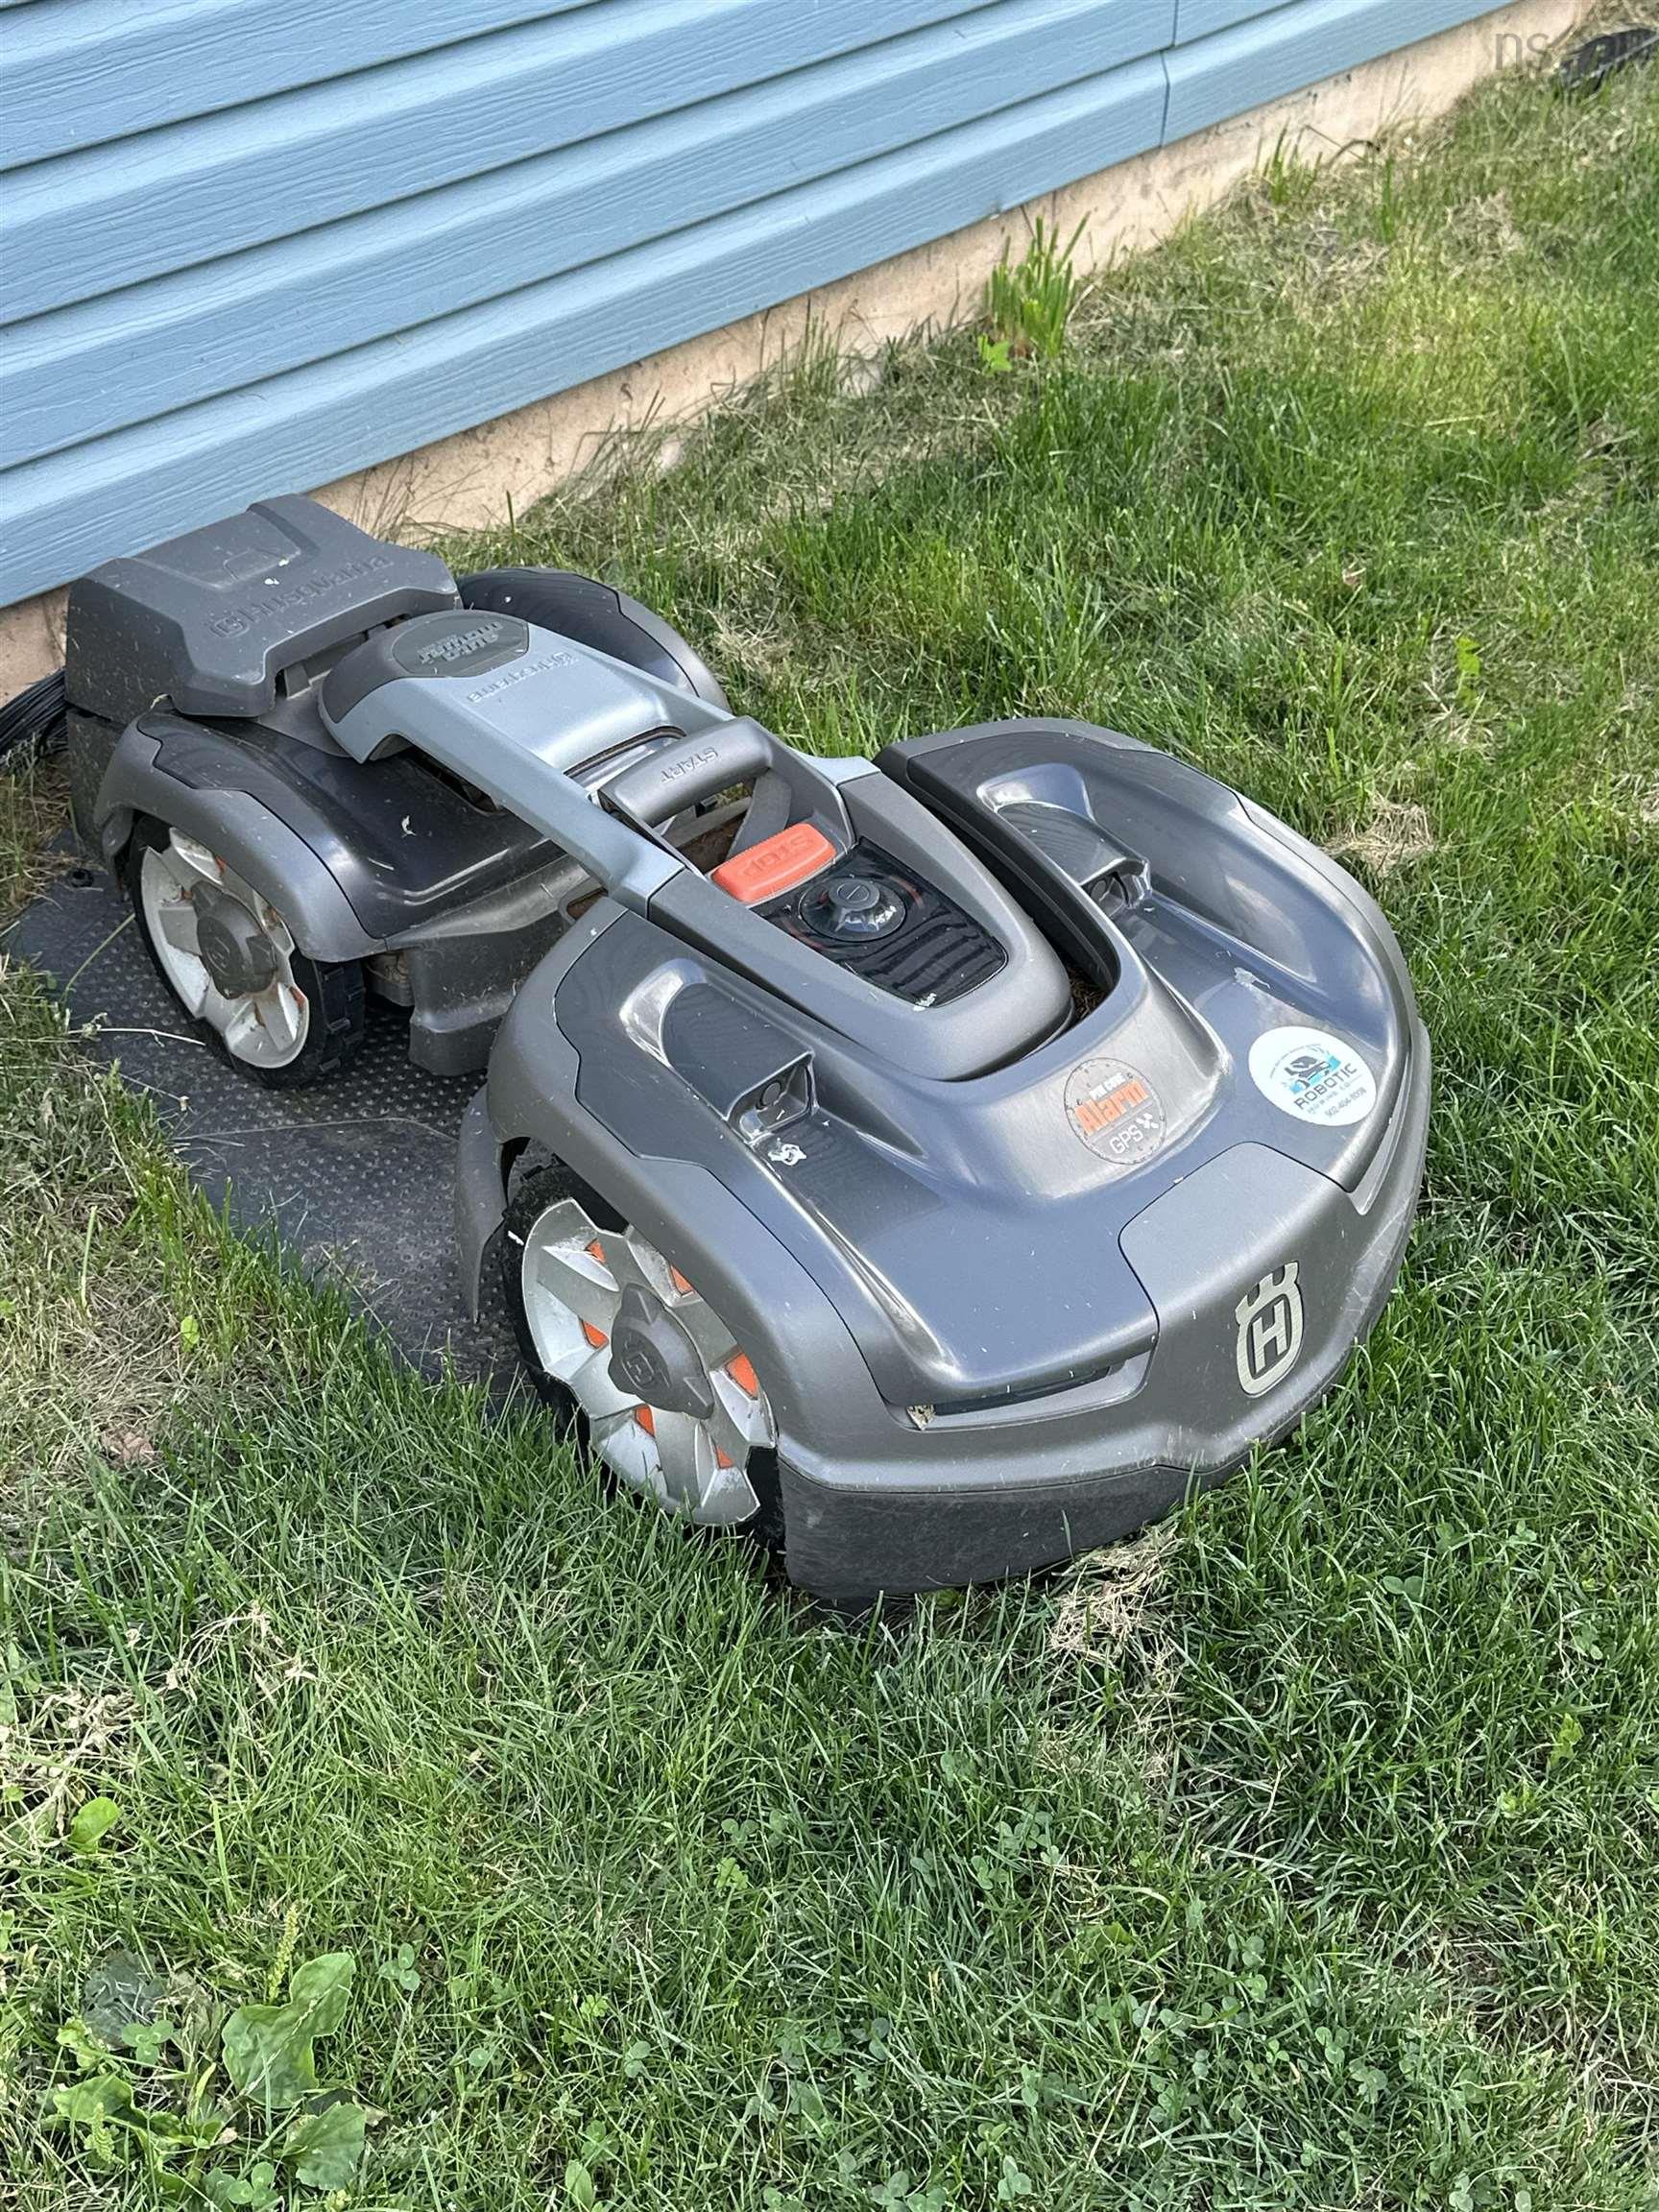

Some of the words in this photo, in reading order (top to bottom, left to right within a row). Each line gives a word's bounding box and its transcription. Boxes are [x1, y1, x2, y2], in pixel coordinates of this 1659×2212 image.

[661, 747, 719, 783] START
[737, 834, 815, 879] STOP
[1074, 1079, 1150, 1137] Alarm
[1293, 1062, 1358, 1110] ROBOTIC
[1109, 1124, 1144, 1155] GPS
